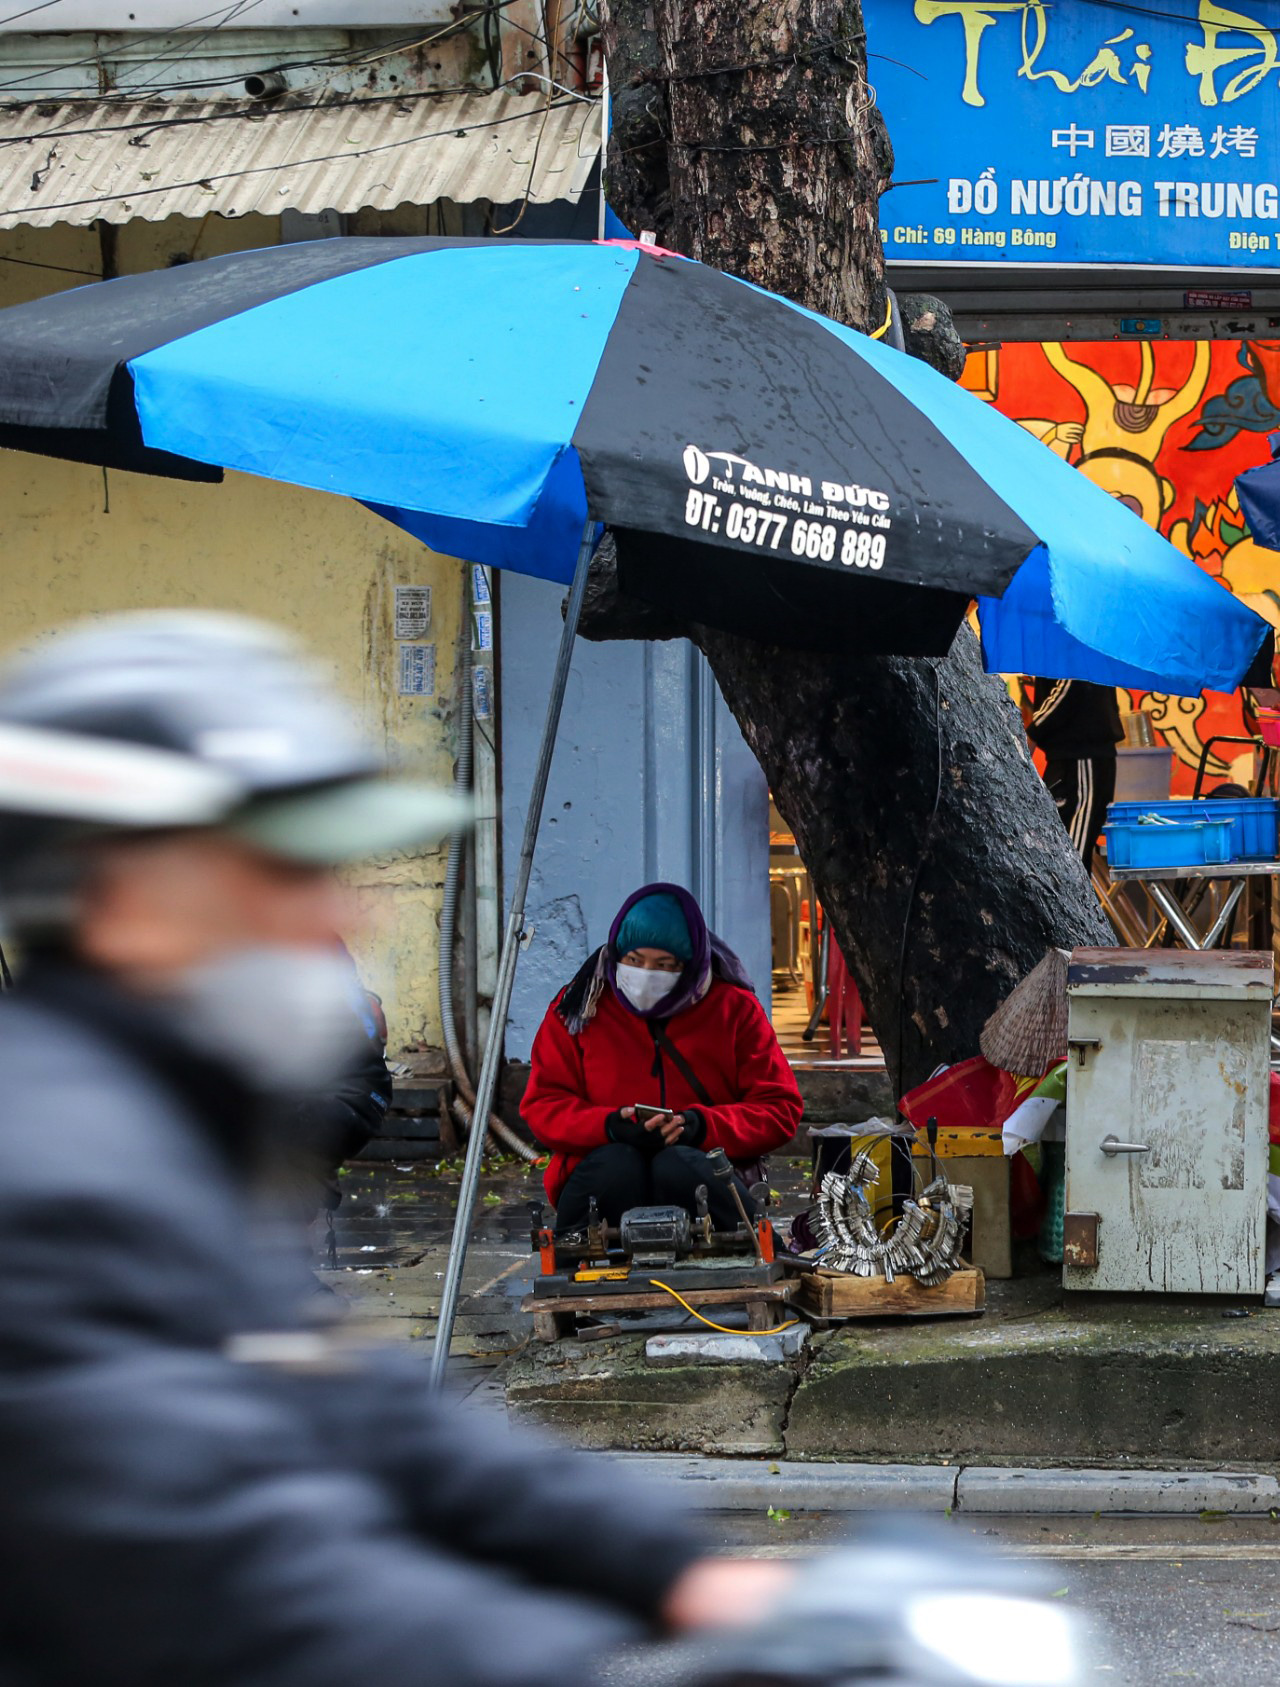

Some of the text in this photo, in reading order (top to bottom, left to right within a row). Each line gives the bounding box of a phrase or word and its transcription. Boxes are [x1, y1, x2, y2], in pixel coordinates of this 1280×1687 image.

[914, 0, 1151, 107] Thái
[1050, 122, 1260, 159] 中國燒烤
[947, 166, 998, 216] ĐỒ
[1010, 173, 1142, 217] NƯỚNG
[1154, 181, 1279, 220] TRUNG
[893, 225, 928, 244] Chỉ:
[933, 227, 956, 244] 69
[961, 227, 1006, 247] Hàng
[1011, 228, 1057, 248] Bông
[1229, 232, 1270, 253] Điện
[821, 480, 890, 511] ĐỨC
[685, 488, 887, 571] ĐT: 0377 668 889
[826, 504, 850, 522] Theo
